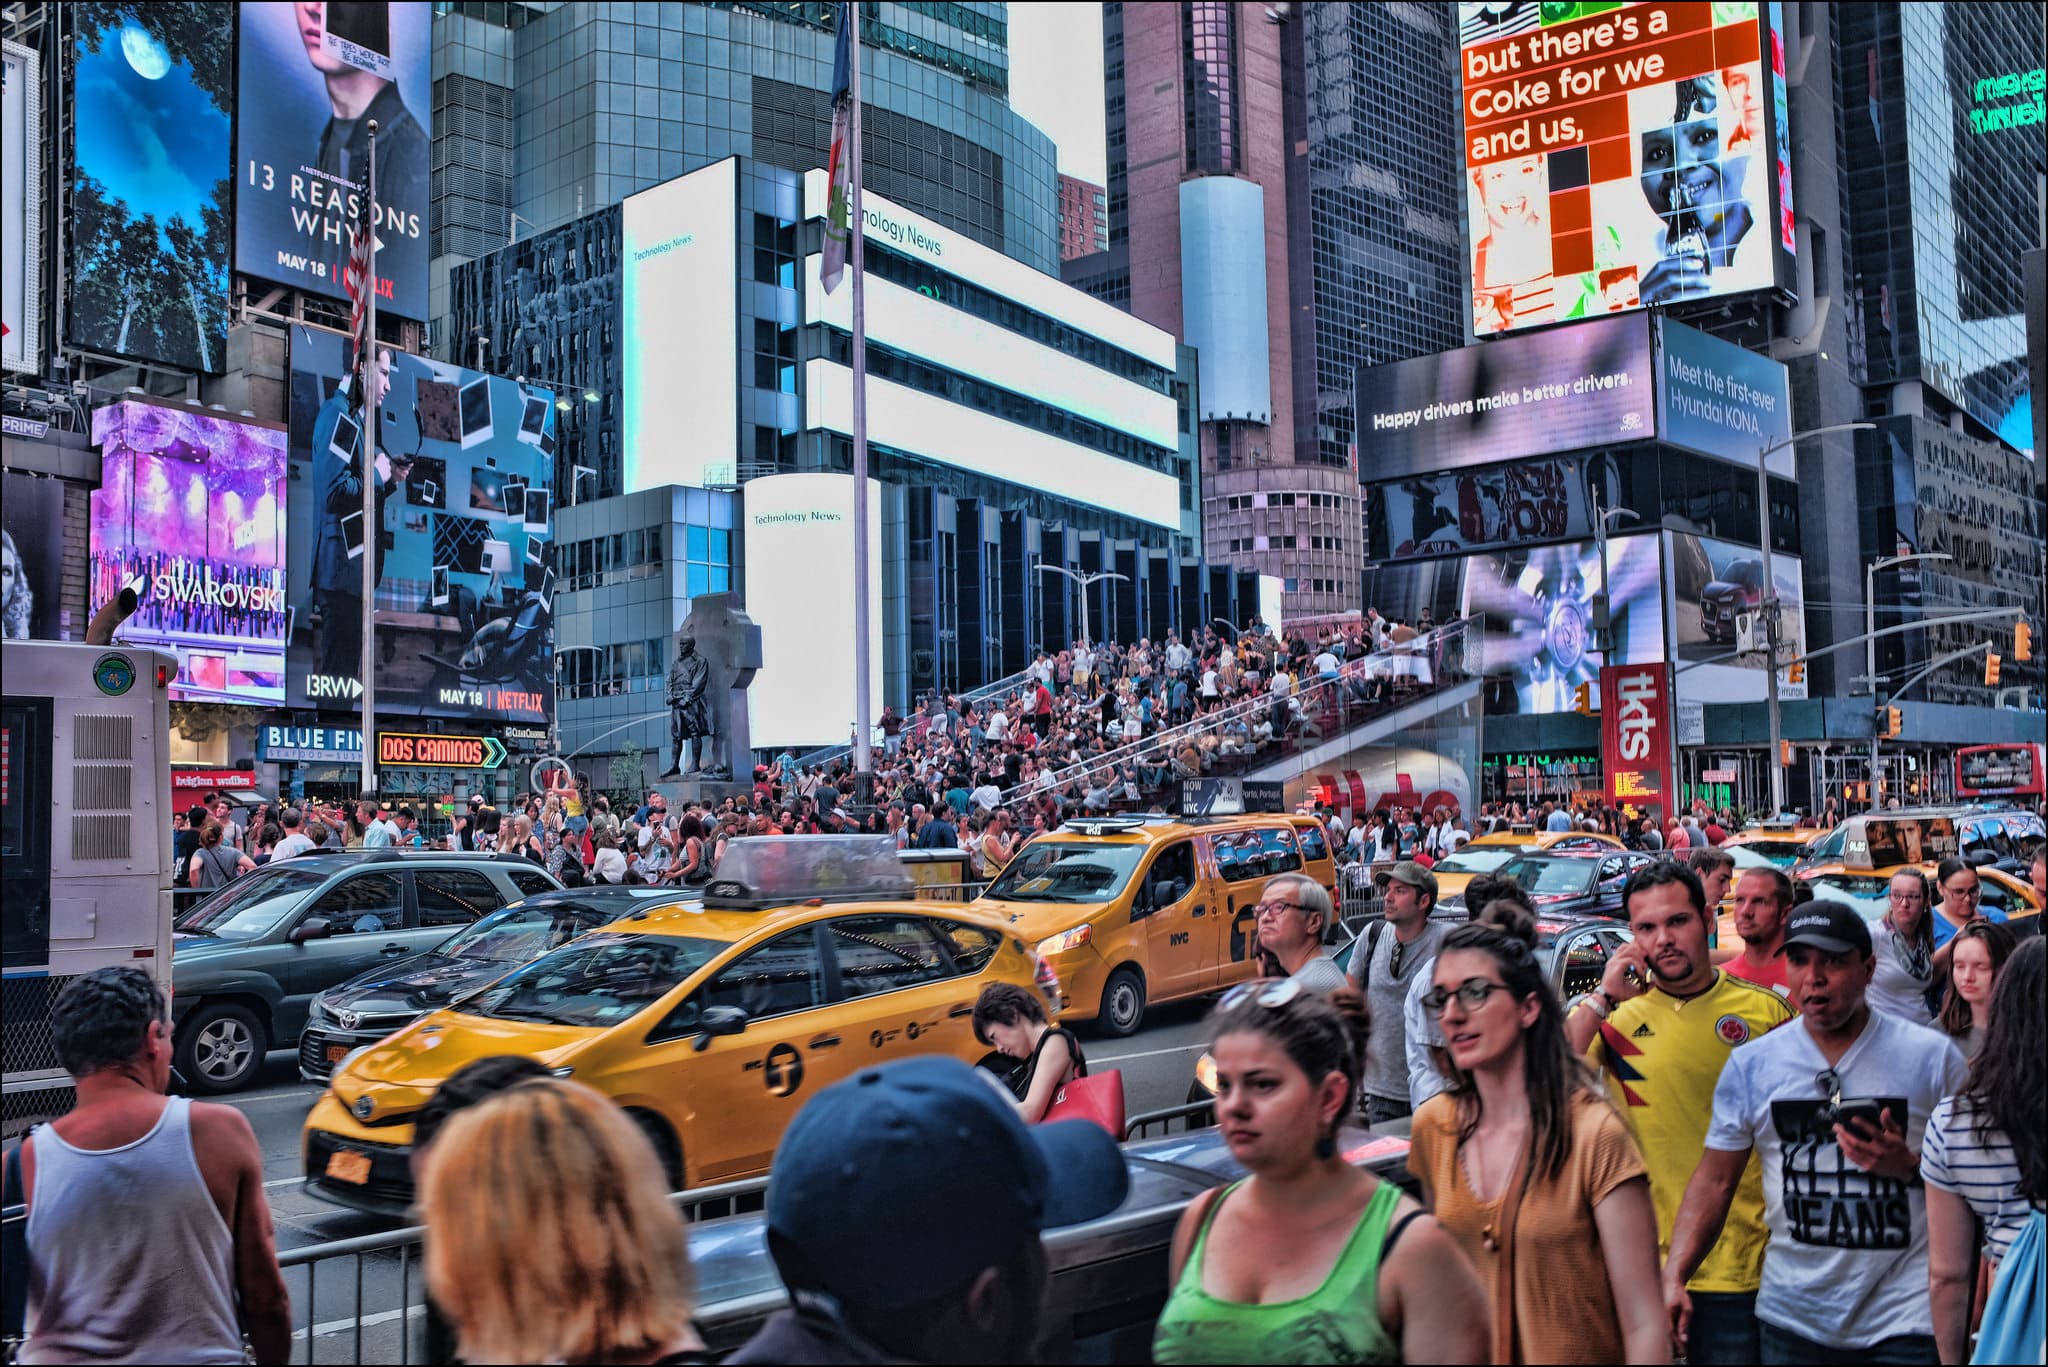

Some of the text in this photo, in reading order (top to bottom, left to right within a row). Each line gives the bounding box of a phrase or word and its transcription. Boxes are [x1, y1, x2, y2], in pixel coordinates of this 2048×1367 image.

[1467, 9, 1669, 79] but there's a
[1469, 53, 1665, 119] Coke for we
[1471, 116, 1584, 160] and us,
[250, 160, 275, 191] 13
[306, 166, 330, 181] NETFLIX
[291, 206, 357, 249] WHY
[907, 225, 942, 257] News
[633, 234, 693, 262] Technology News
[278, 250, 307, 270] MAY
[310, 261, 326, 277] 18
[1669, 354, 1776, 414] Meet the first-ever
[1373, 370, 1633, 431] Happy drivers make better drivers.
[1671, 385, 1763, 438] Hyundai KONA.
[2, 418, 43, 436] PRIME
[755, 511, 841, 525] Technology News
[155, 574, 286, 613] SWAROVSKI
[440, 688, 543, 713] MAY 18 NETFLIX
[1617, 672, 1657, 761] tkts
[269, 726, 324, 749] BLUE
[383, 738, 482, 764] DOS CAMINOS
[269, 748, 322, 759] SEAFOOD
[176, 775, 249, 788] belgian waffles
[1183, 780, 1202, 791] NOW
[1183, 791, 1192, 802] IN
[1183, 803, 1198, 814] NYC
[1170, 932, 1189, 947] NYC
[1784, 1196, 1911, 1249] JEANS
